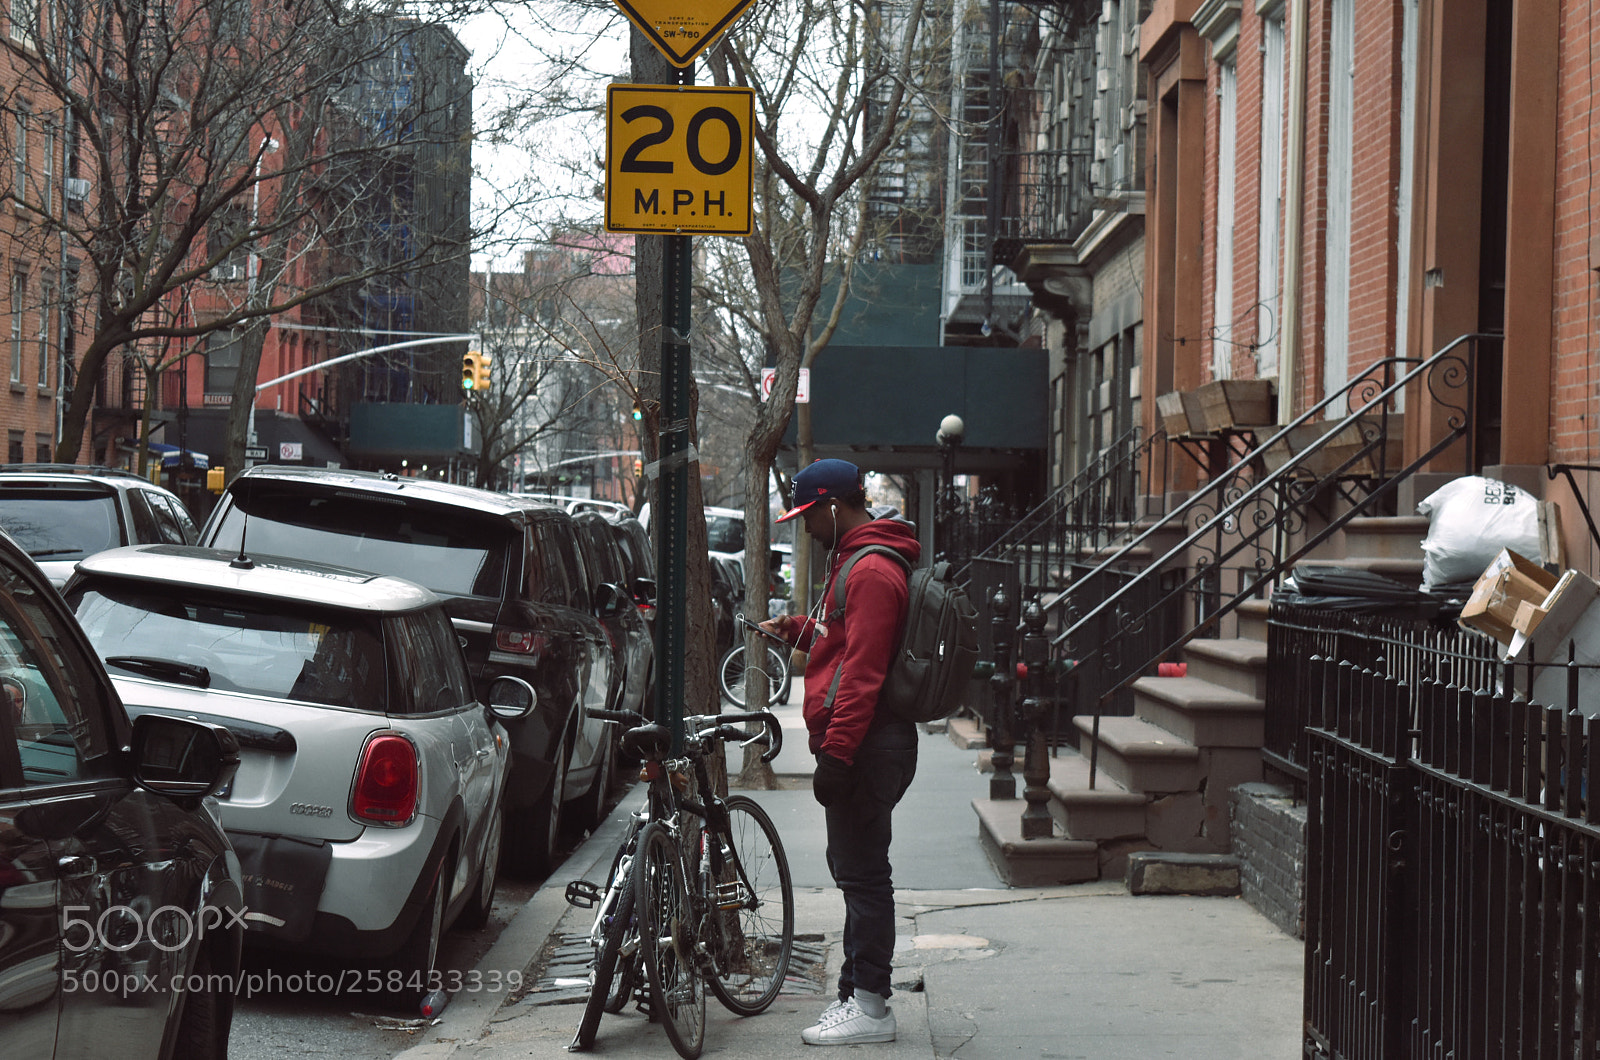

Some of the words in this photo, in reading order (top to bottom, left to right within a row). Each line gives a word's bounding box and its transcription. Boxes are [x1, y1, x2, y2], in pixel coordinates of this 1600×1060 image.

[664, 30, 700, 39] SW-780
[620, 104, 742, 176] 20
[634, 187, 733, 217] M.P.H.
[290, 802, 333, 817] COOPER
